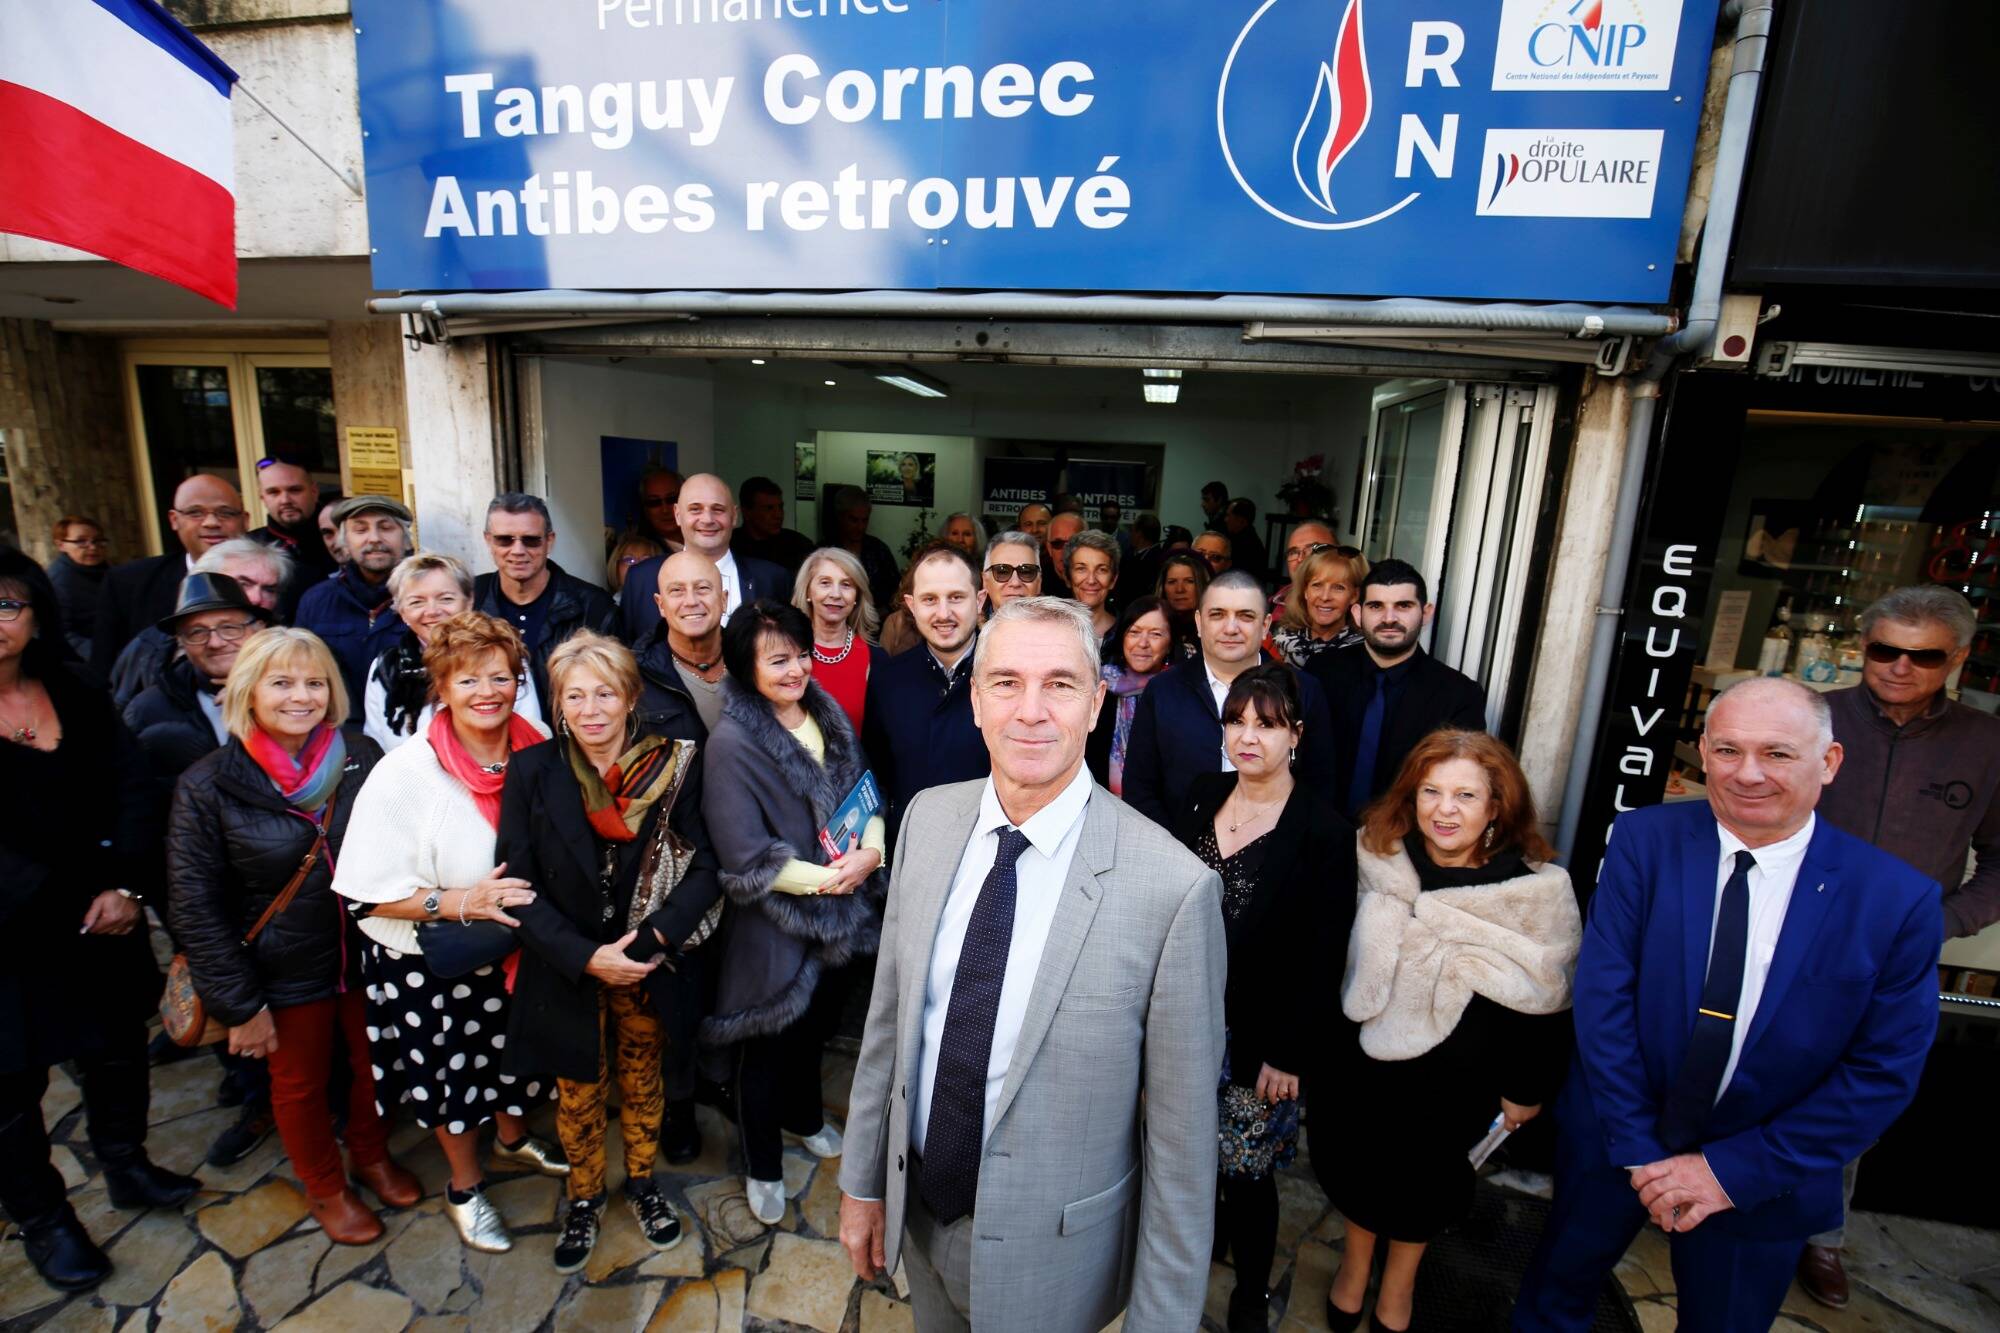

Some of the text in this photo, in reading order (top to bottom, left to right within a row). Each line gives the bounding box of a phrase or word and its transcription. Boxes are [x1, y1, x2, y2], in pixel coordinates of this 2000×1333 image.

[1405, 21, 1465, 87] R
[1528, 22, 1648, 67] CNIP
[1505, 72, 1528, 81] Centre
[1530, 72, 1560, 81] National
[1562, 72, 1573, 81] des
[1622, 72, 1630, 81] et
[1632, 72, 1659, 82] Paysans
[445, 54, 1094, 150] Tanguy Cornec
[1395, 113, 1459, 178] N
[1529, 140, 1585, 158] droite
[424, 156, 1130, 238] Antibes retrouvé
[989, 487, 1047, 501] ANTIBES
[989, 503, 1023, 513] RETRO
